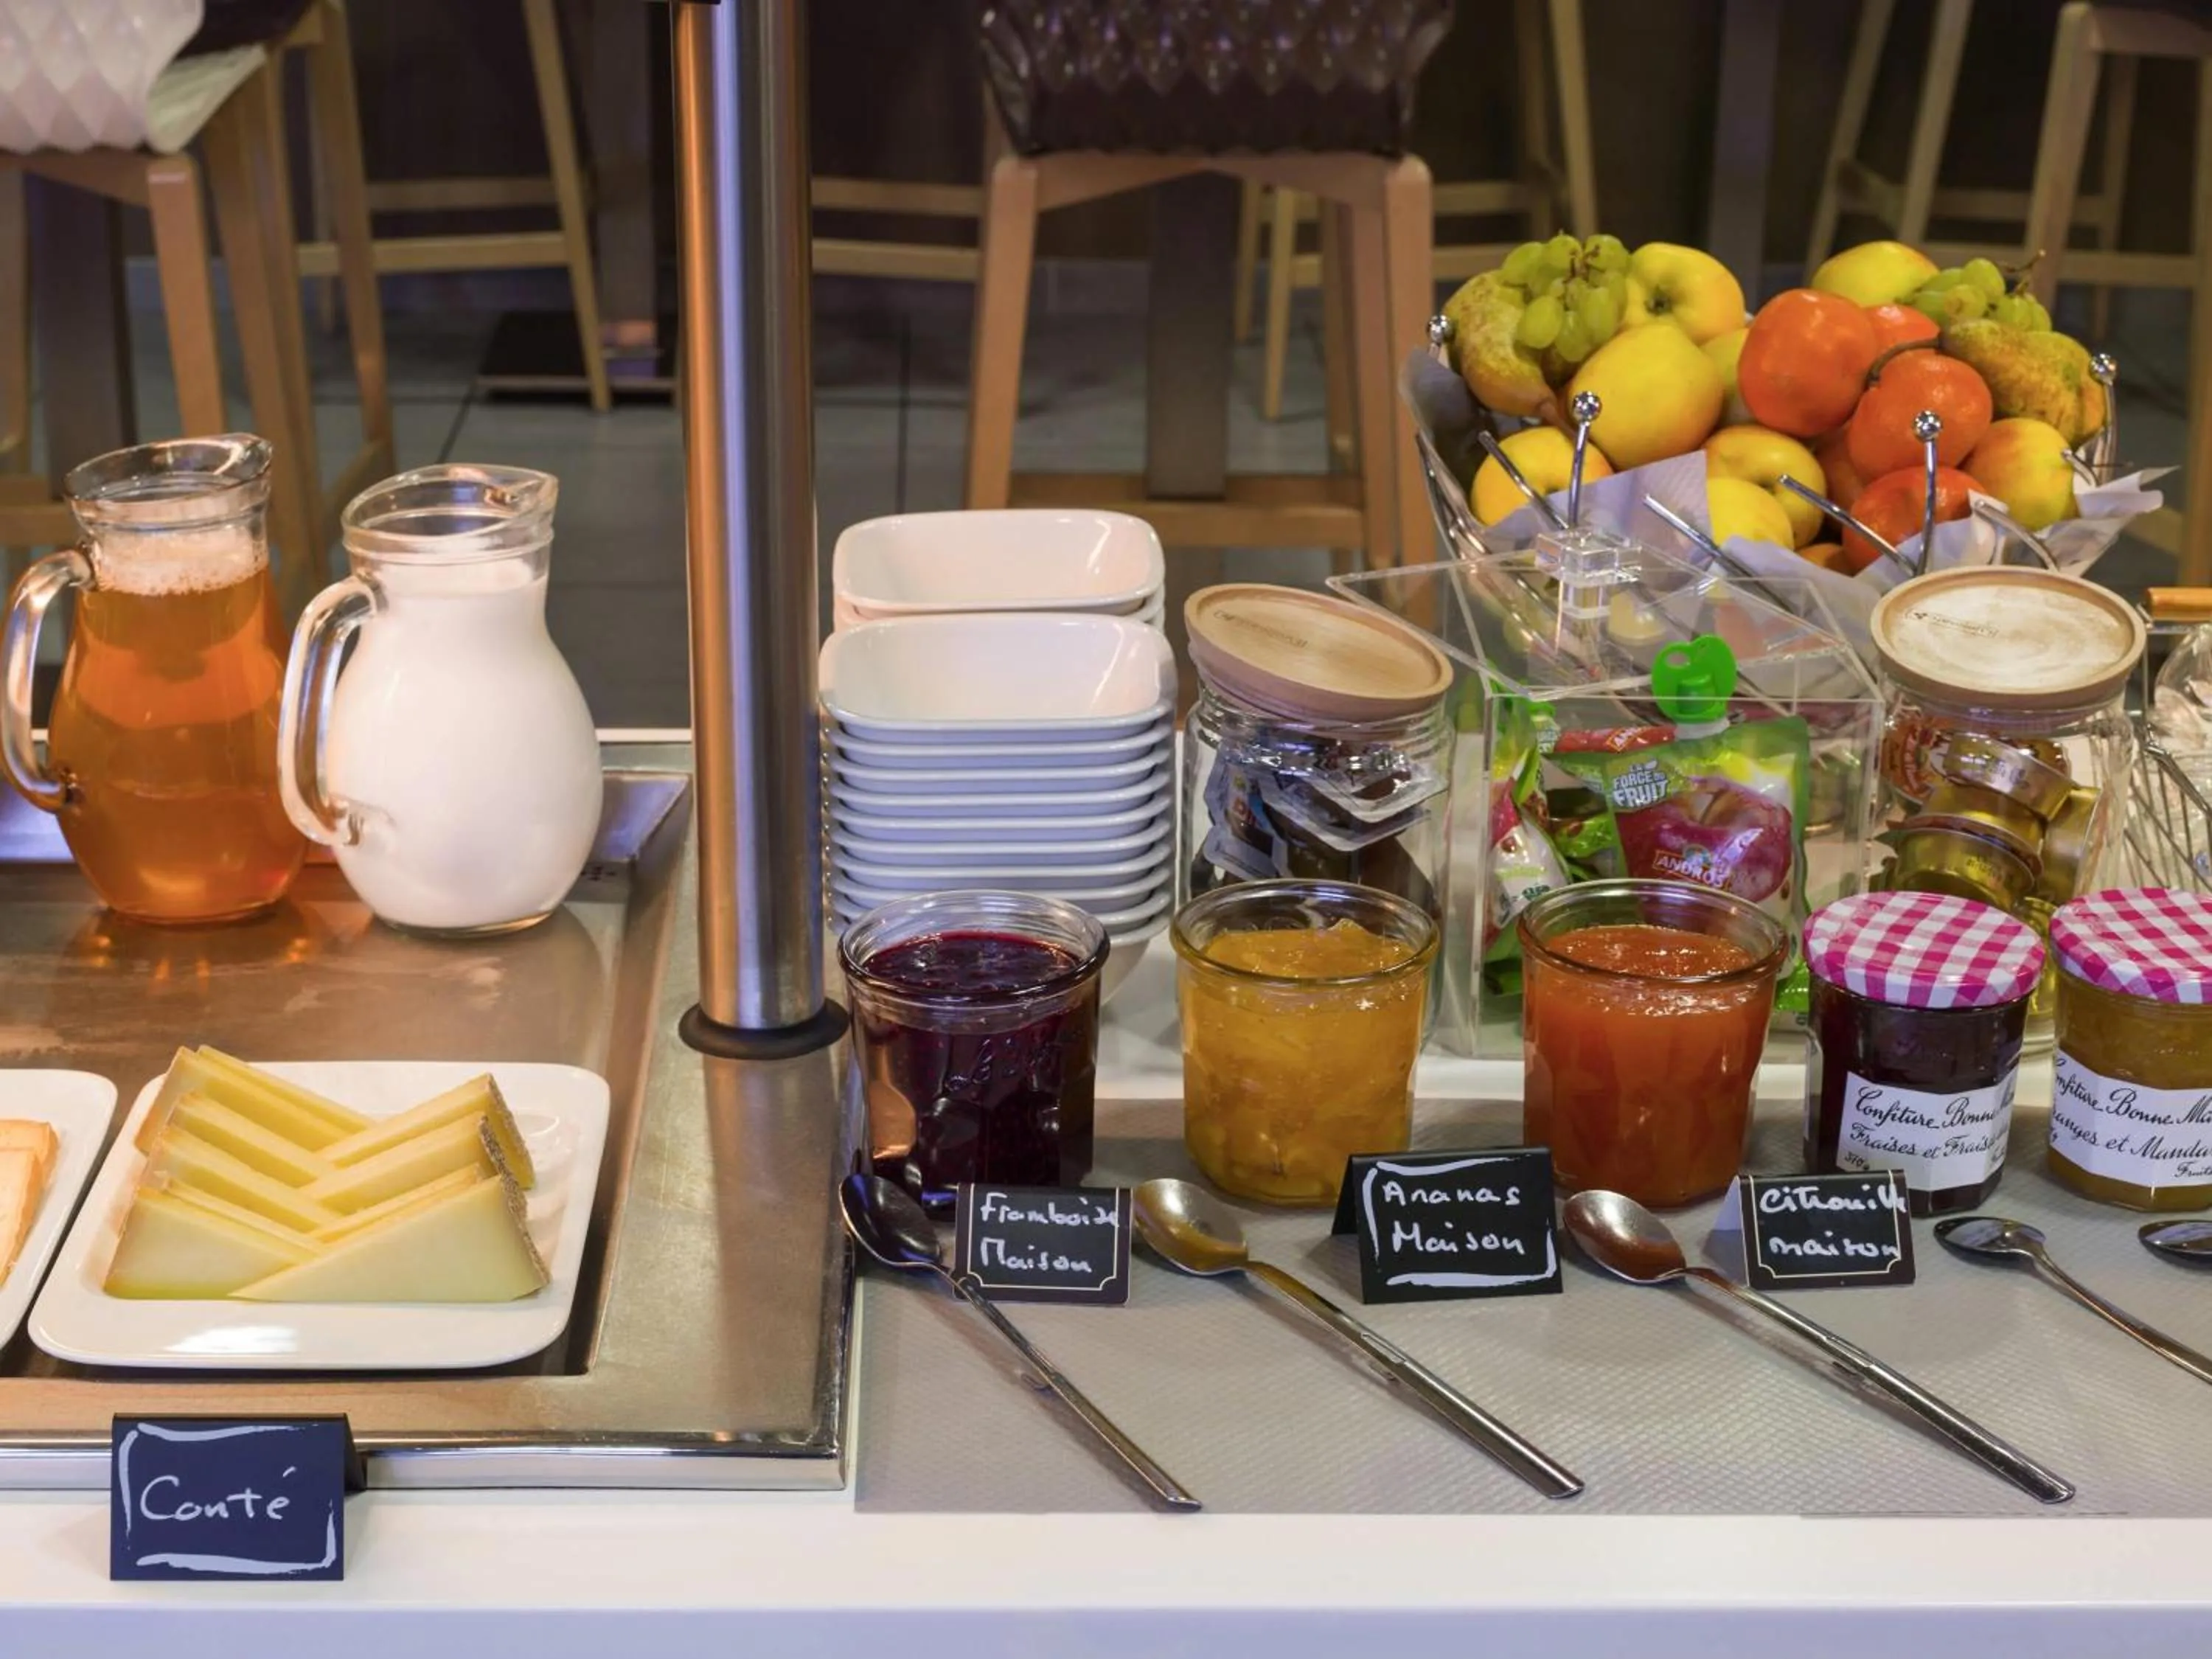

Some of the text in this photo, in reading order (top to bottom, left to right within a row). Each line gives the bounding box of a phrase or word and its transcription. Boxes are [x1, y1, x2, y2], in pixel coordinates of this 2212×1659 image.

[1613, 771, 1653, 790] FORCE
[1613, 779, 1669, 808] FRUIT
[1657, 855, 1724, 888] ANDROS
[1855, 1086, 1940, 1129] Confiture
[2106, 1088, 2174, 1124] Bonne
[1849, 1122, 1918, 1155] Fraises
[1922, 1146, 1941, 1159] et
[2105, 1134, 2129, 1152] et
[1382, 1180, 1521, 1206] Ananas
[980, 1237, 1093, 1273] Maison
[1391, 1220, 1526, 1255] Maison
[139, 1466, 297, 1521] Conté
